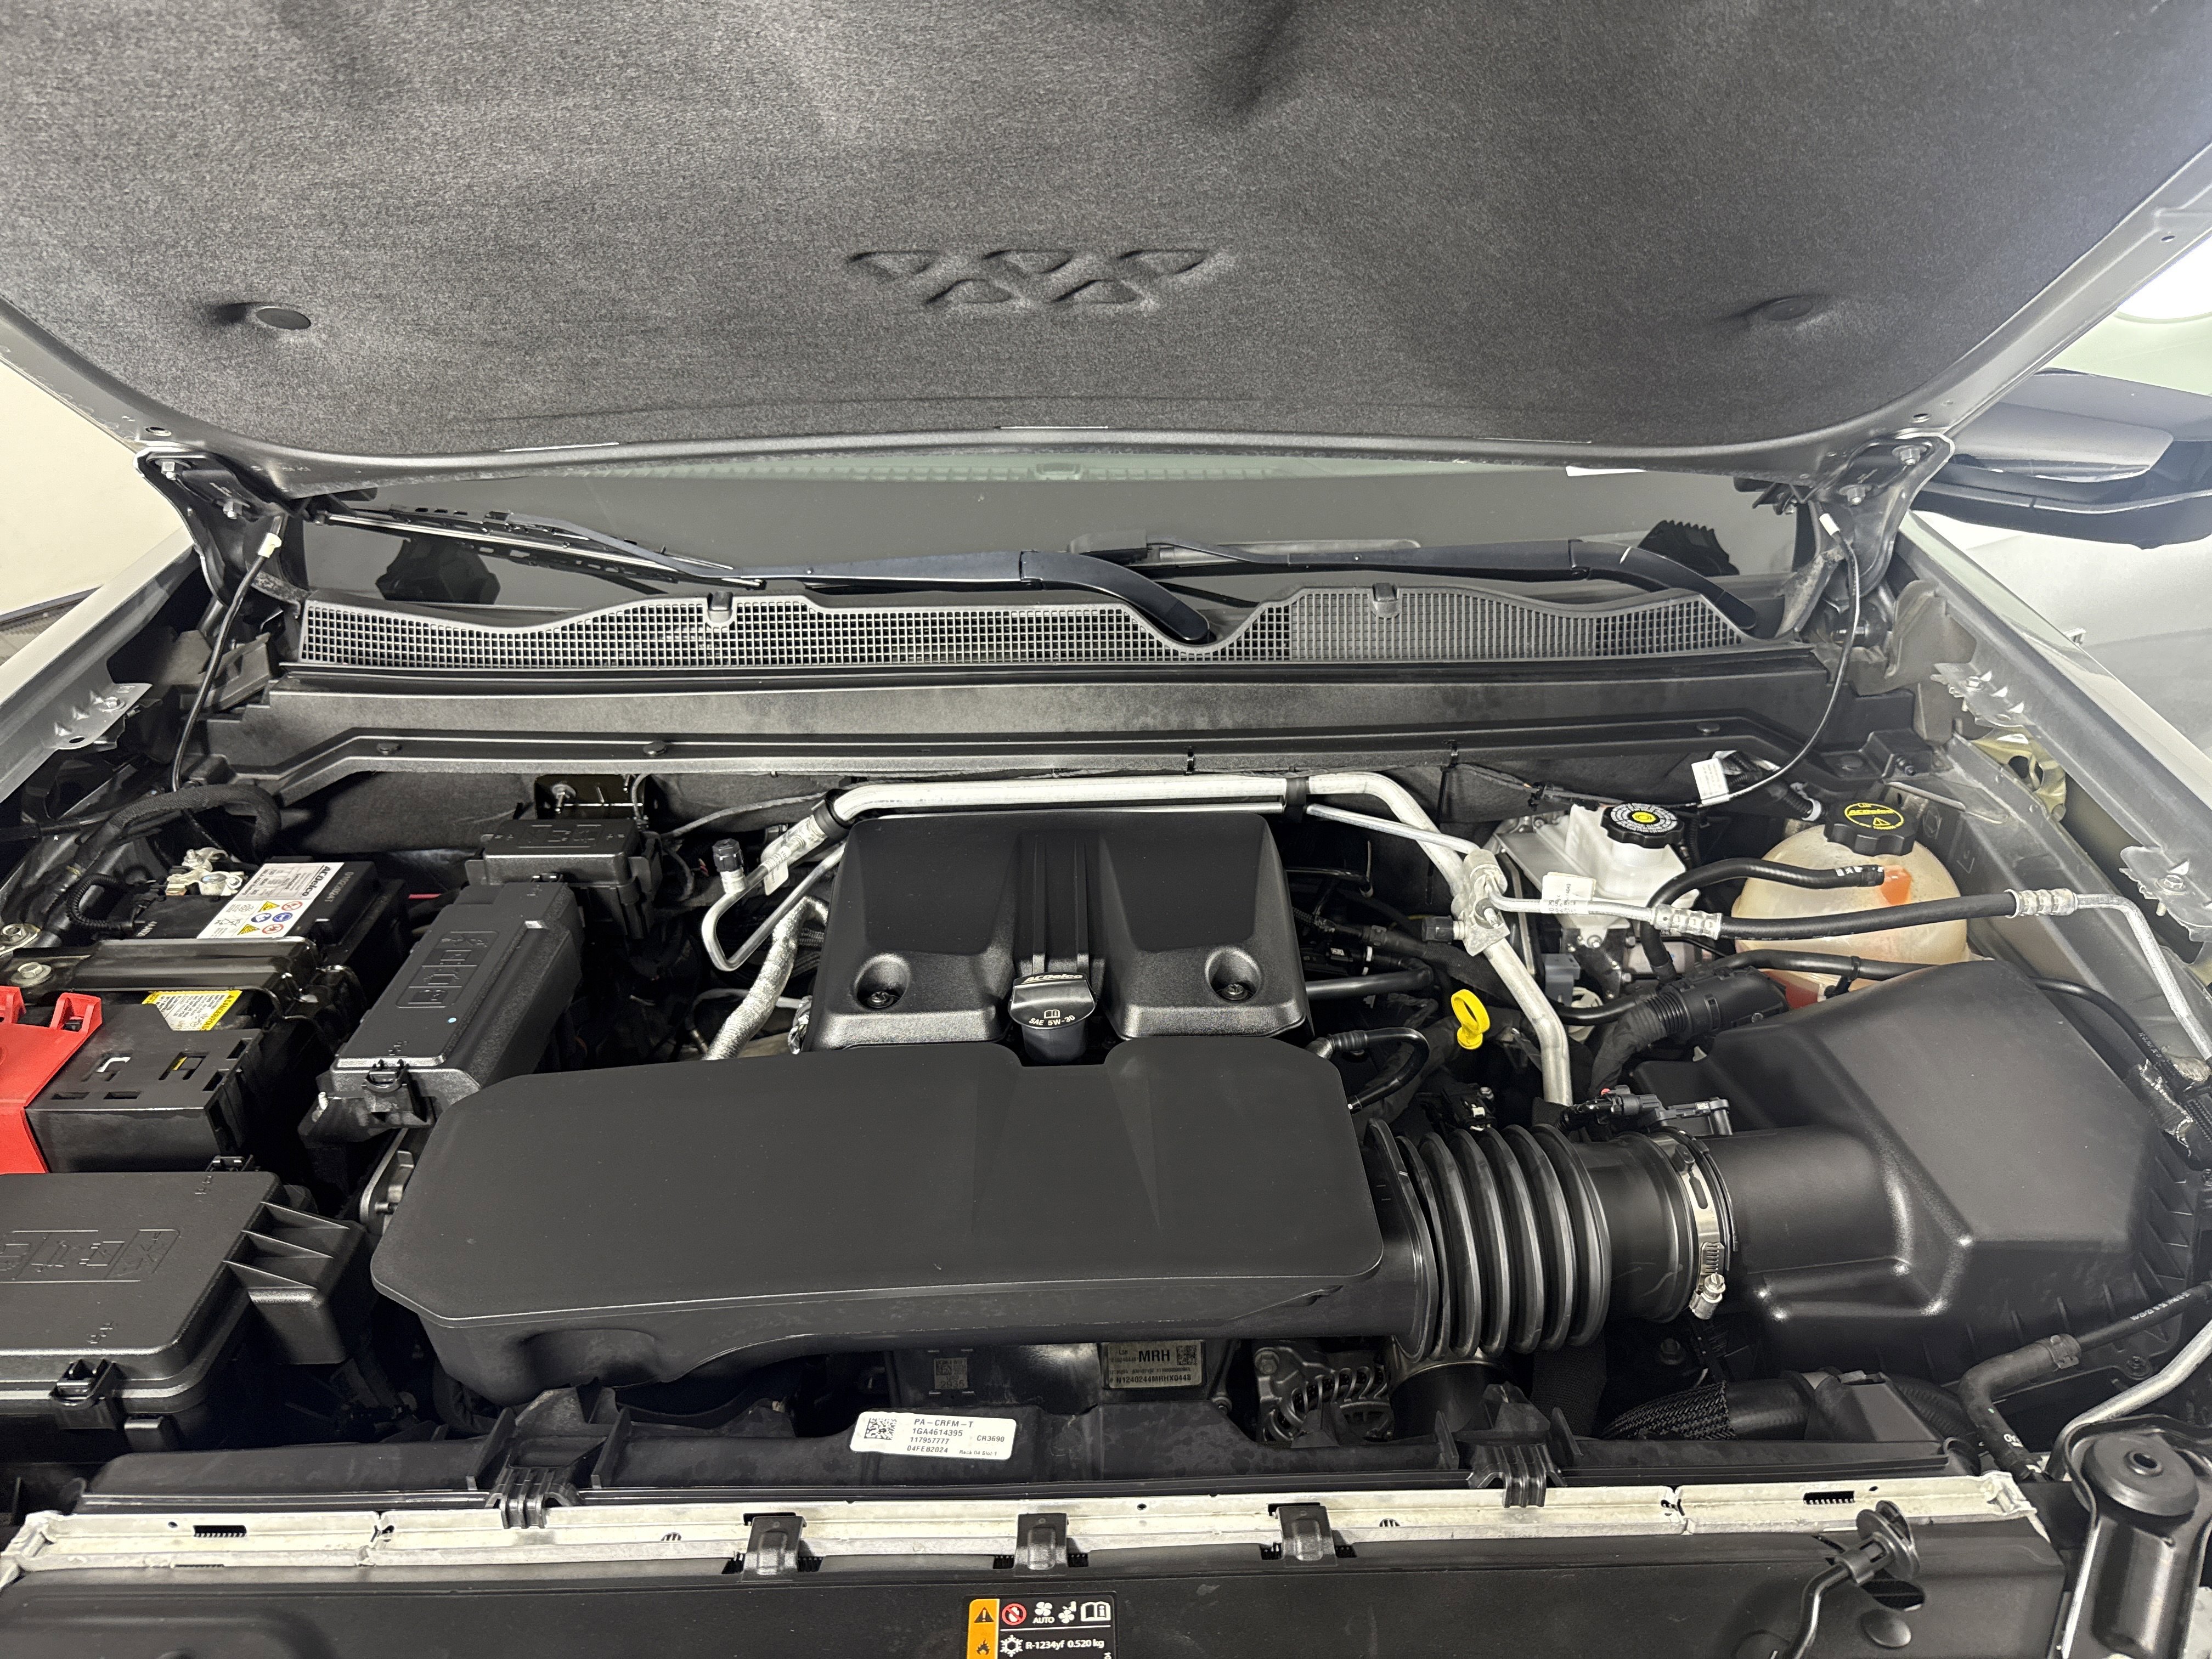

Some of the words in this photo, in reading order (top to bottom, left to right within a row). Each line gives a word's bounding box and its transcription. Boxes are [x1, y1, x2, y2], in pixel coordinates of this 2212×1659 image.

[302, 865, 332, 896] ACDelco
[1023, 974, 1084, 983] ACDelco
[1048, 1015, 1075, 1026] 5W-30
[1138, 1349, 1170, 1362] MRH
[912, 1427, 963, 1437] 1GA4614395
[910, 1436, 950, 1444] 117957777
[907, 1445, 949, 1453] 04FEB2024
[1025, 1640, 1064, 1651] R-1234yf
[1068, 1640, 1091, 1648] 0.520
[1093, 1639, 1104, 1649] kg
